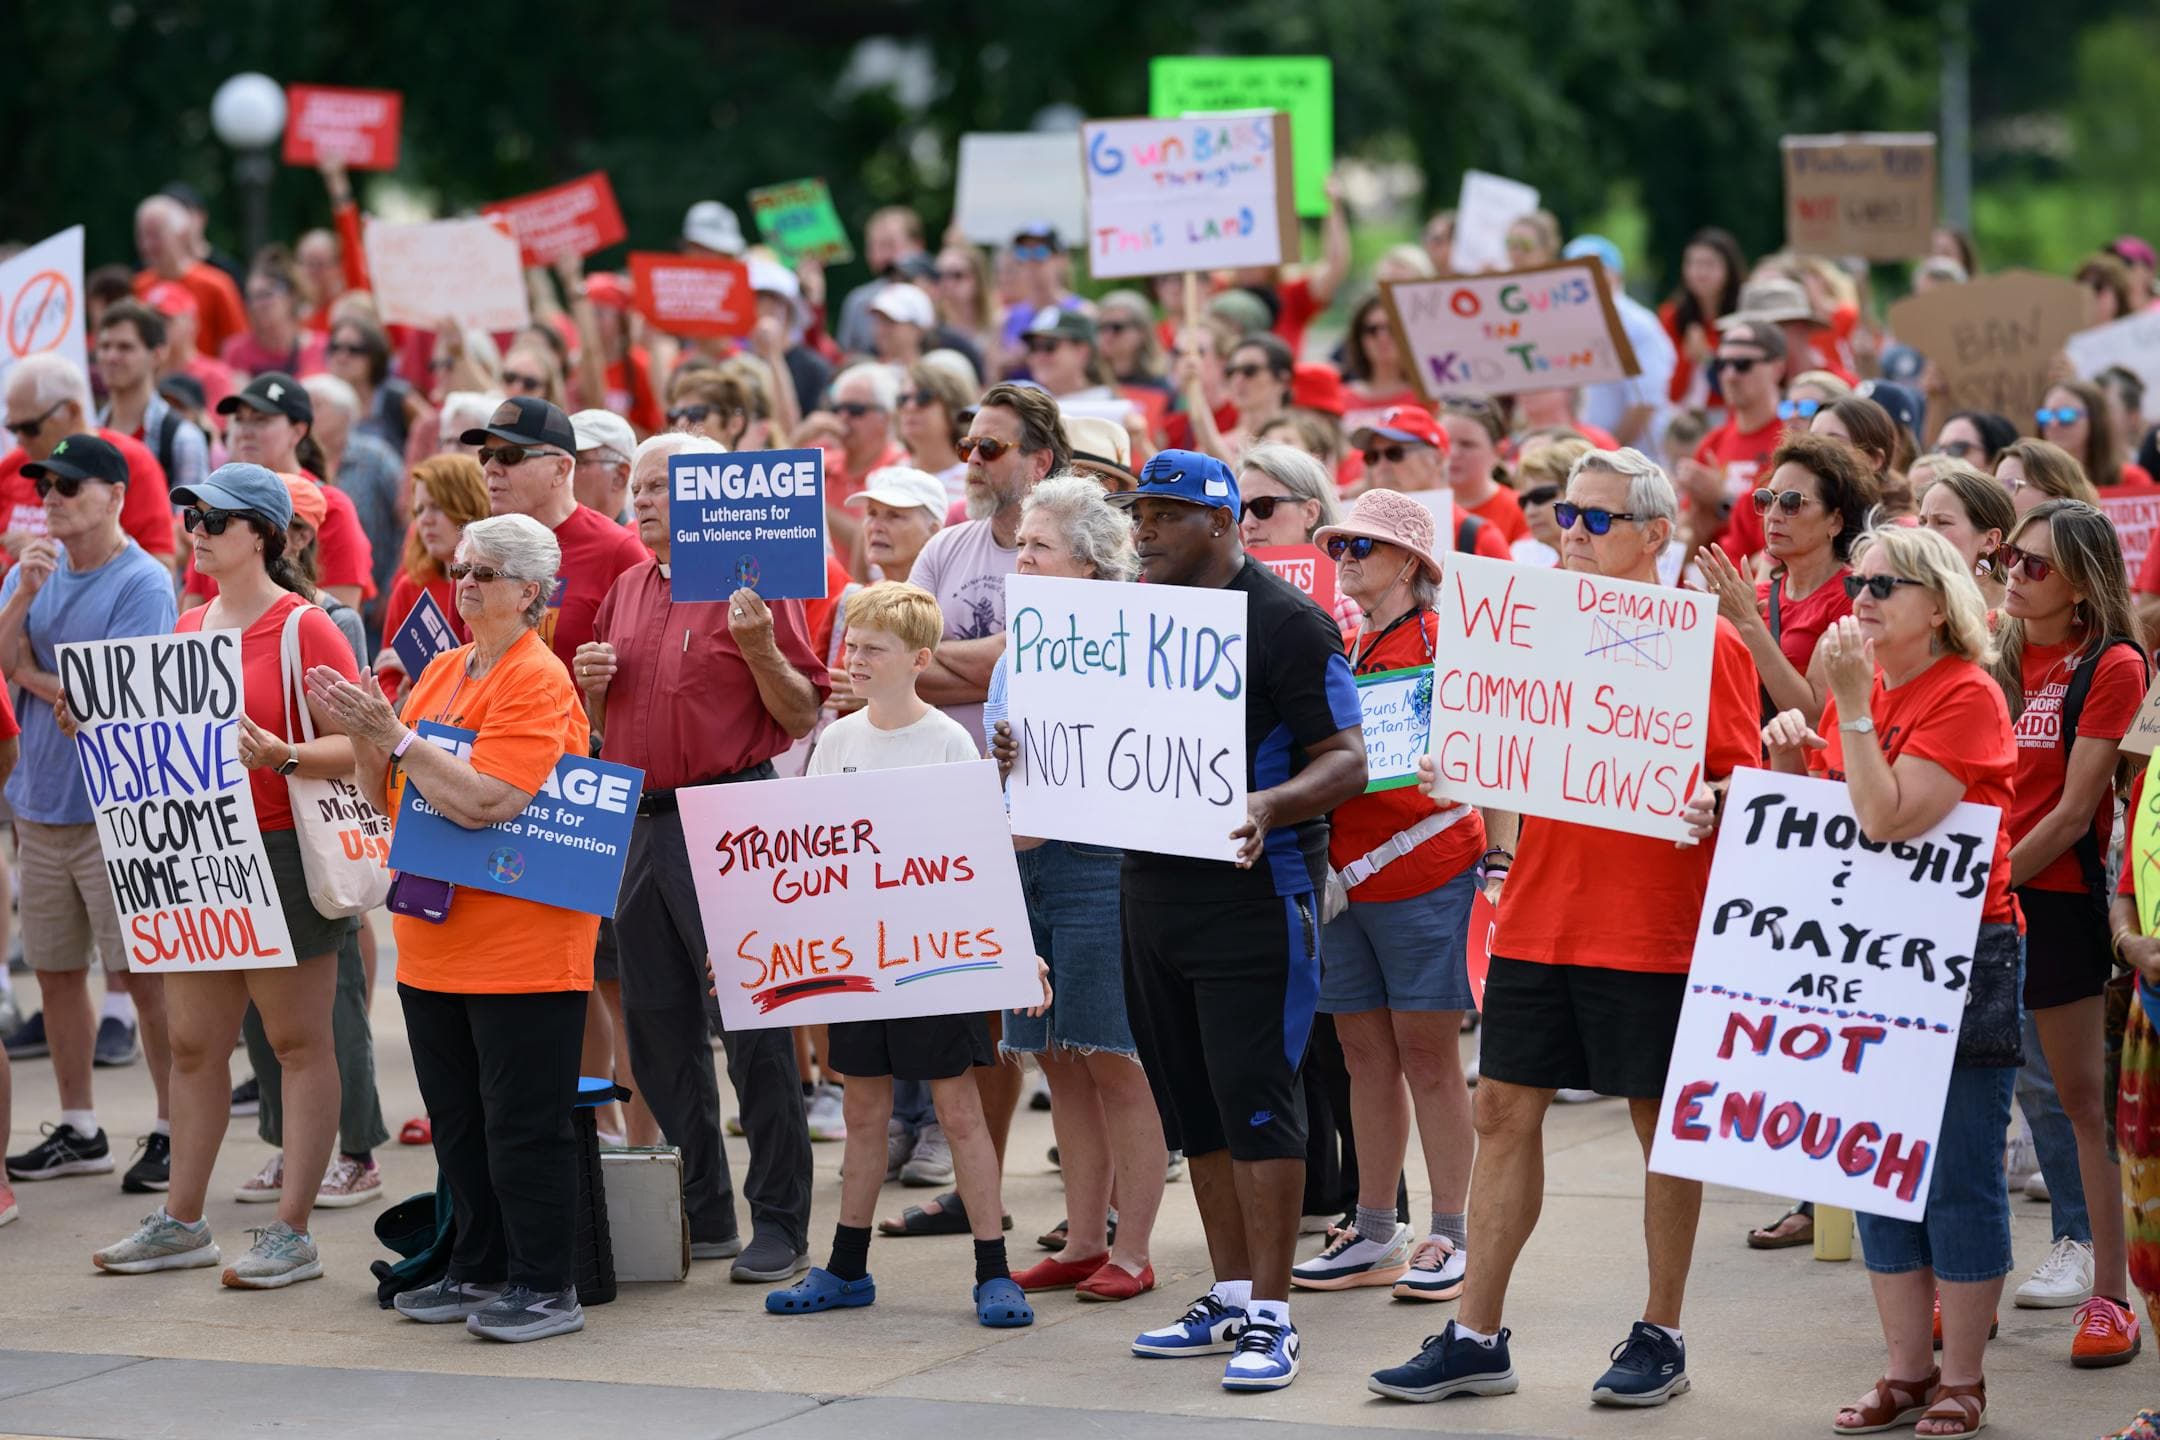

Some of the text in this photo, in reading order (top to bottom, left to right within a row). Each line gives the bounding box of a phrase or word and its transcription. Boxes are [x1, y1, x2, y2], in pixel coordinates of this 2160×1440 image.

[675, 462, 816, 501] ENGAGE
[677, 525, 817, 543] Gun Violence Prevention
[702, 505, 790, 523] Lutherans for
[1456, 571, 1537, 648] WE
[60, 634, 238, 723] OUR KIDS
[1012, 606, 1242, 700] Protect KIDS
[1361, 691, 1397, 717] Guns
[1440, 669, 1573, 728] COMMON
[75, 718, 243, 807] DESERVE
[1024, 717, 1233, 806] NOT GUNS
[1441, 731, 1534, 793] GUN
[102, 794, 247, 854] TO COME
[526, 824, 617, 856] Prevention
[555, 808, 585, 828] for
[715, 818, 881, 876] STRONGER
[107, 853, 271, 915] HOME FROM
[772, 855, 975, 904] GUN LAWS
[131, 906, 282, 966] SCHOOL
[737, 920, 1003, 990] SAVES LIVES
[1713, 898, 1973, 991] PRAYERS
[1788, 973, 1863, 1004] ARE
[1717, 1011, 1888, 1074] NOT
[1671, 1079, 1931, 1201] ENOUGH
